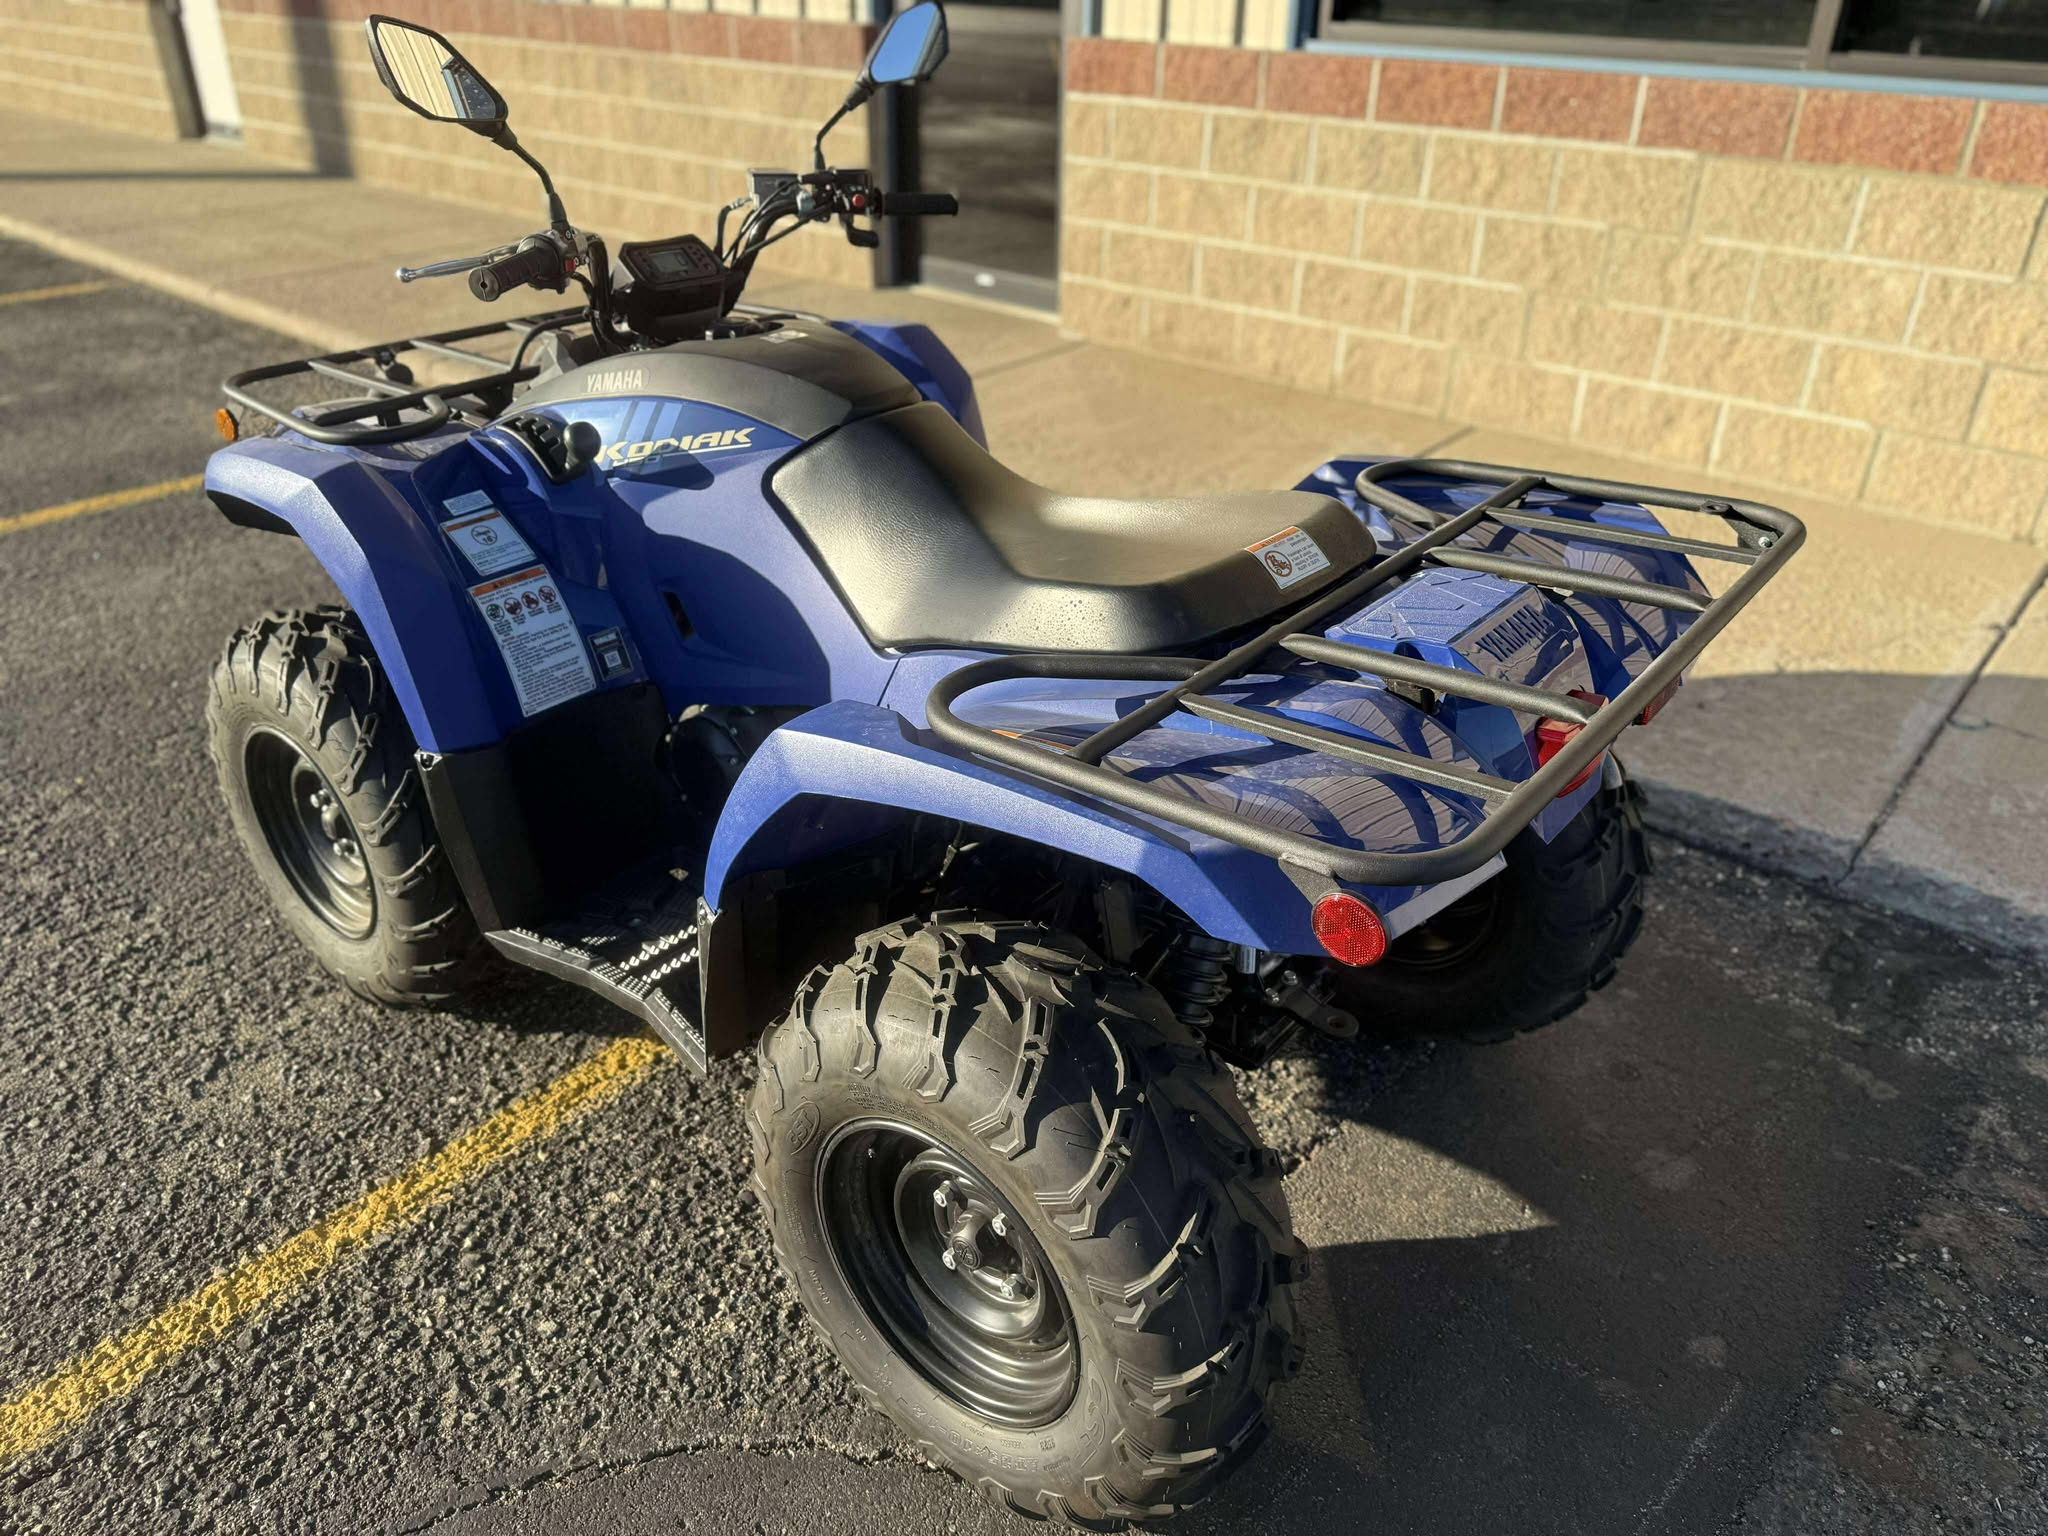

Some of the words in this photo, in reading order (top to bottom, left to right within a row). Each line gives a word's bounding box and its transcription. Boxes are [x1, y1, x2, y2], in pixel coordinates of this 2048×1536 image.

[586, 368, 643, 393] YAMAHA
[594, 427, 756, 465] KODIAK
[1474, 603, 1552, 663] YAMAHA
